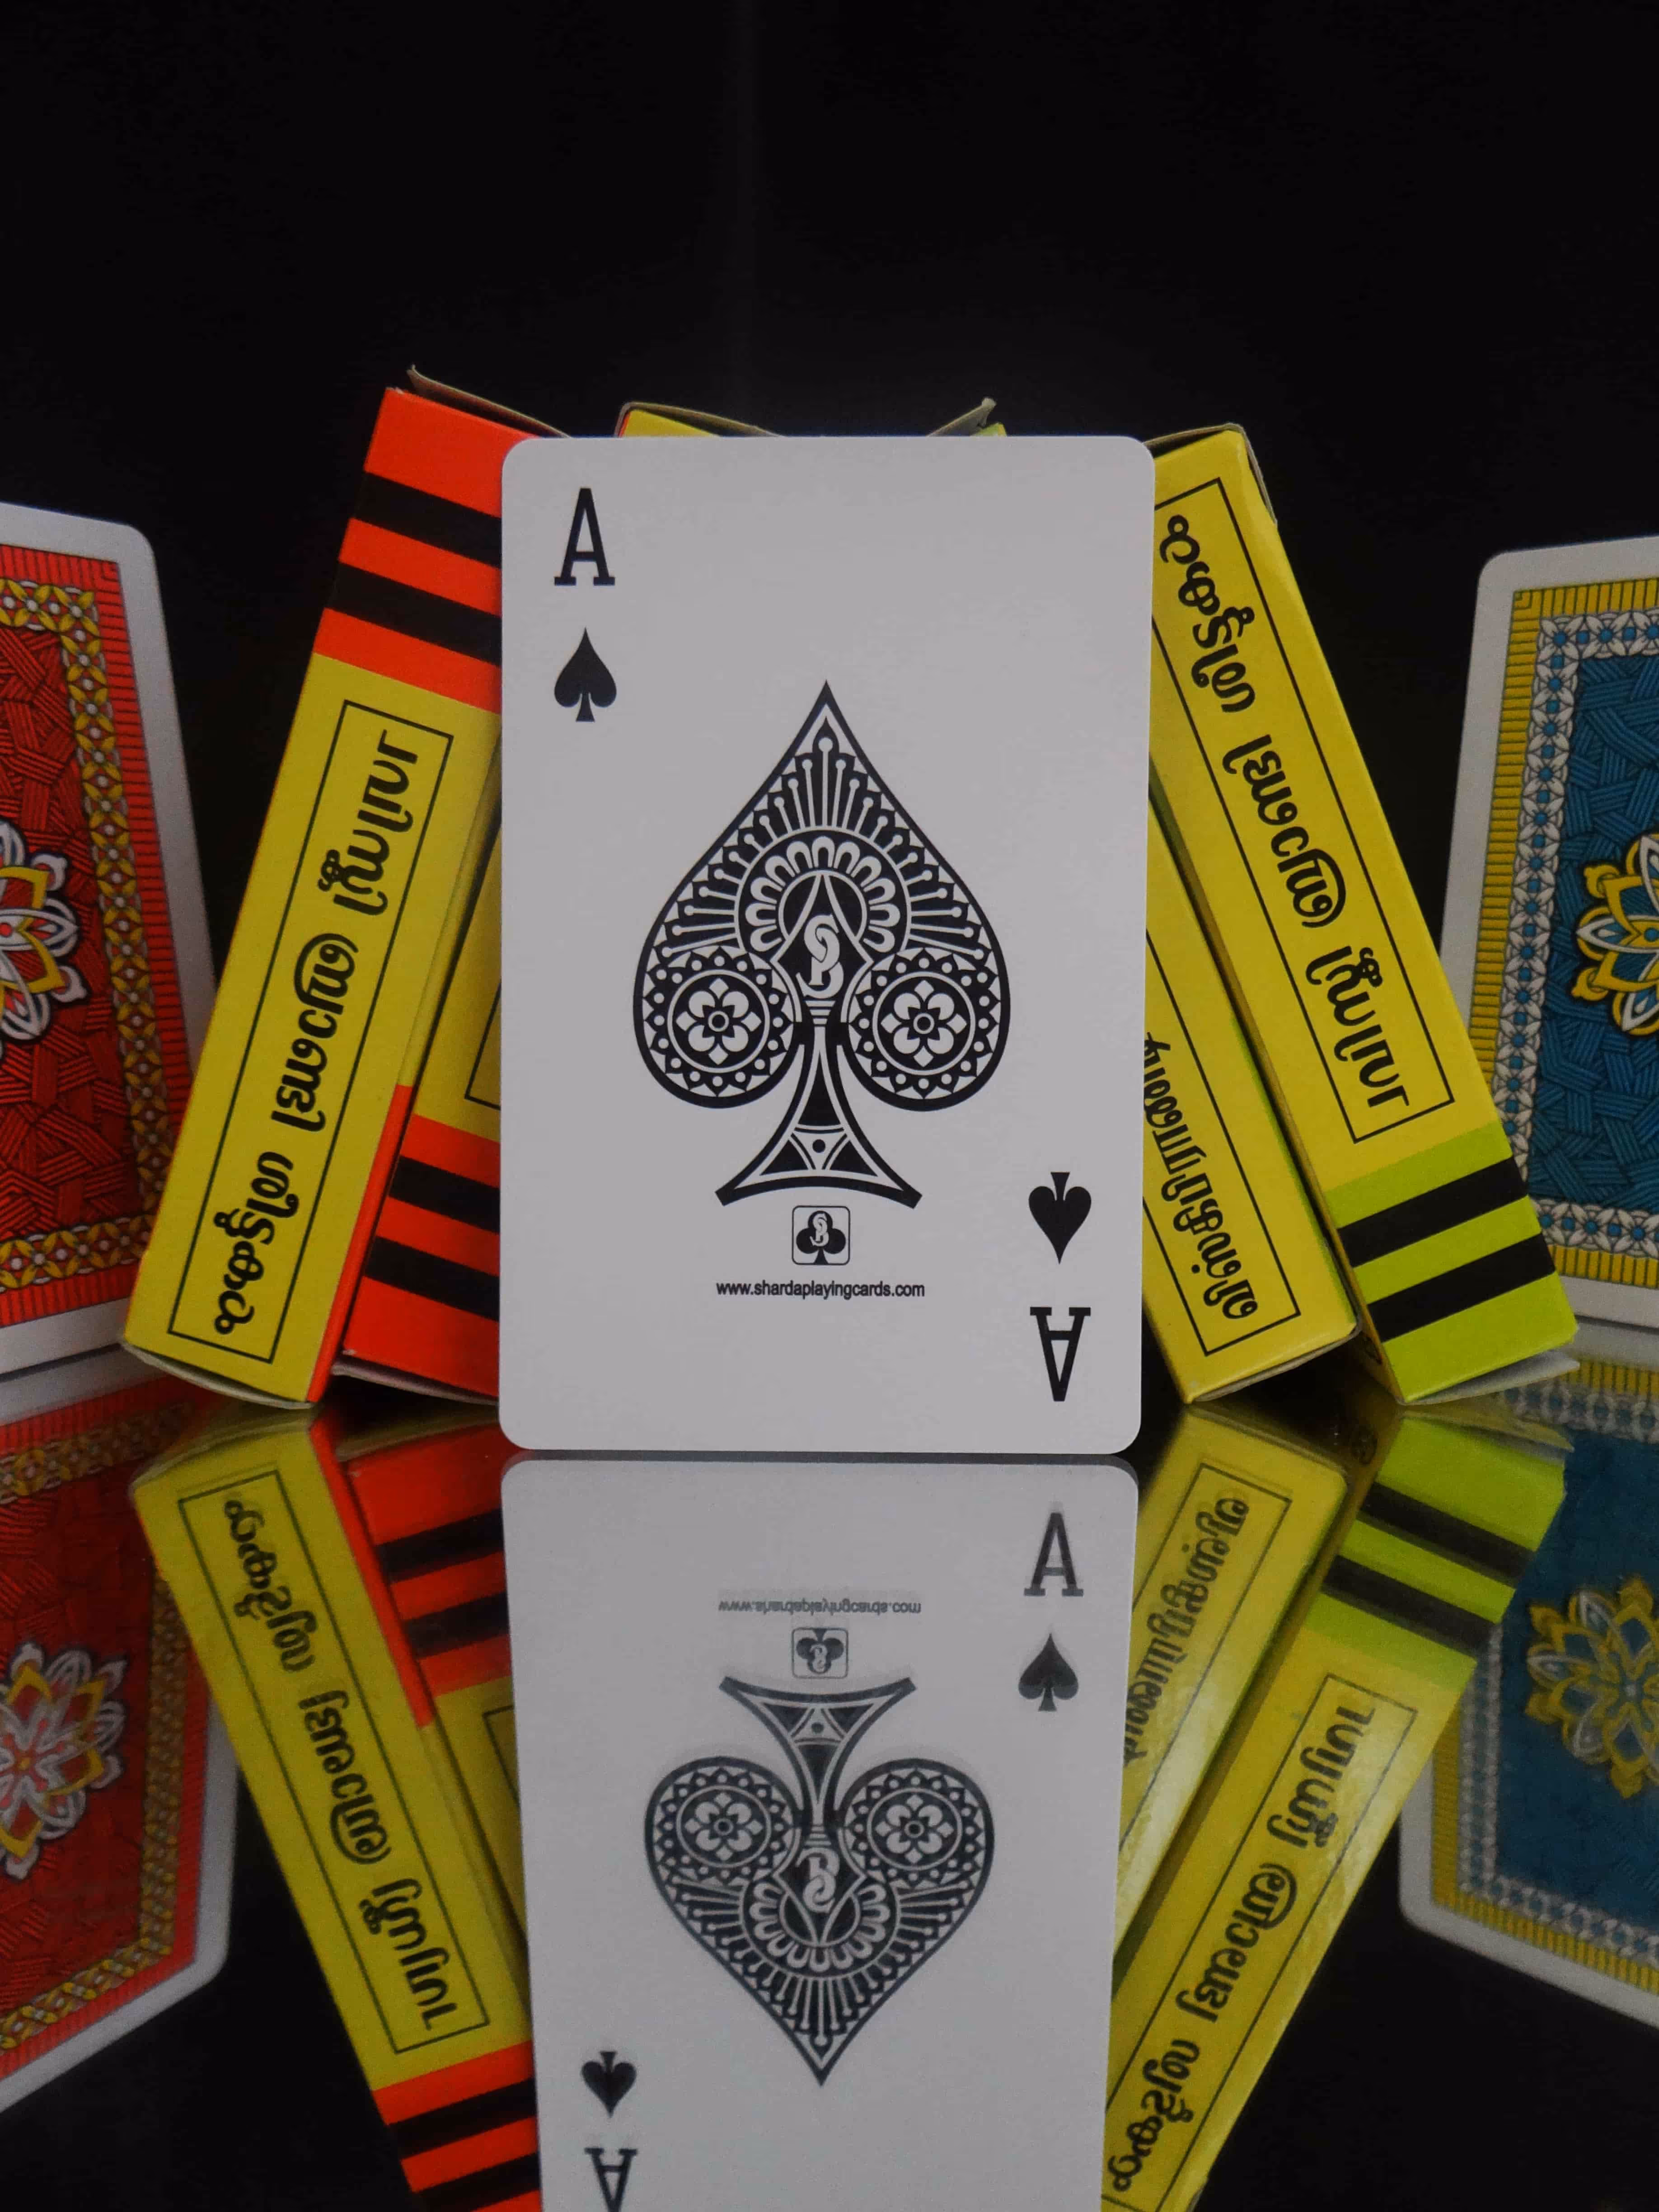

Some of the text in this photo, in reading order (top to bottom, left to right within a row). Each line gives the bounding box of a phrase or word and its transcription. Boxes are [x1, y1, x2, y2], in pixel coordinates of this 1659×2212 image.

[554, 487, 615, 586] A
[716, 1279, 925, 1300] www.shardaplayingcards.com
[1030, 1307, 1091, 1401] A
